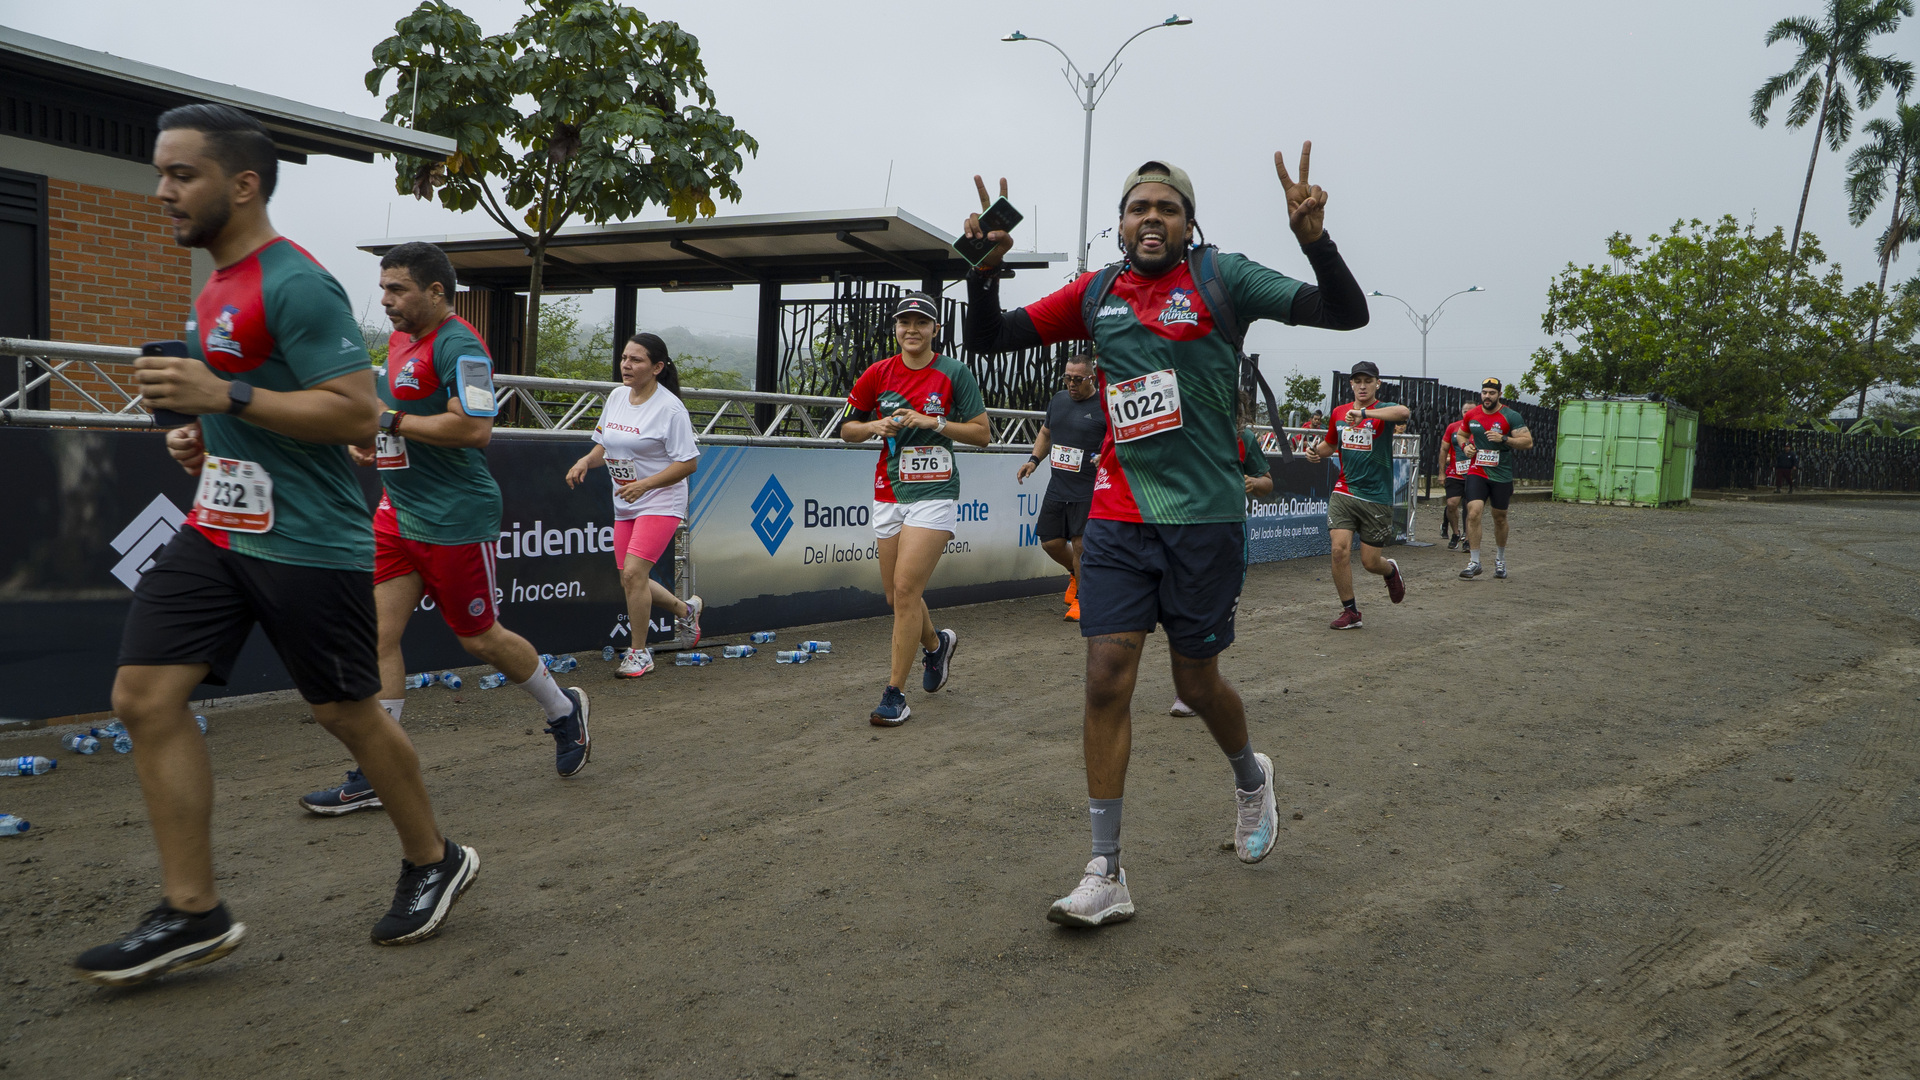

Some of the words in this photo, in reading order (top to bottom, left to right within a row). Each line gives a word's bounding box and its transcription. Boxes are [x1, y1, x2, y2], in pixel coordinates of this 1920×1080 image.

[1114, 391, 1166, 423] 1022
[606, 422, 641, 435] HONDA
[1348, 434, 1364, 444] 412
[911, 457, 939, 471] 576
[1059, 453, 1070, 463] 83
[1479, 454, 1496, 462] 2202
[609, 466, 630, 478] 353
[212, 480, 249, 509] 232
[1017, 493, 1038, 516] TU
[804, 498, 869, 529] Banco
[1251, 499, 1278, 518] Banco
[1278, 498, 1289, 516] de
[1290, 497, 1328, 516] Occidente
[496, 520, 615, 559] cidente
[1018, 522, 1038, 547] IM
[1250, 527, 1261, 540] Del
[803, 544, 828, 565] Del
[831, 542, 863, 563] lado
[941, 540, 972, 555] acen.
[510, 578, 586, 603] hacen.
